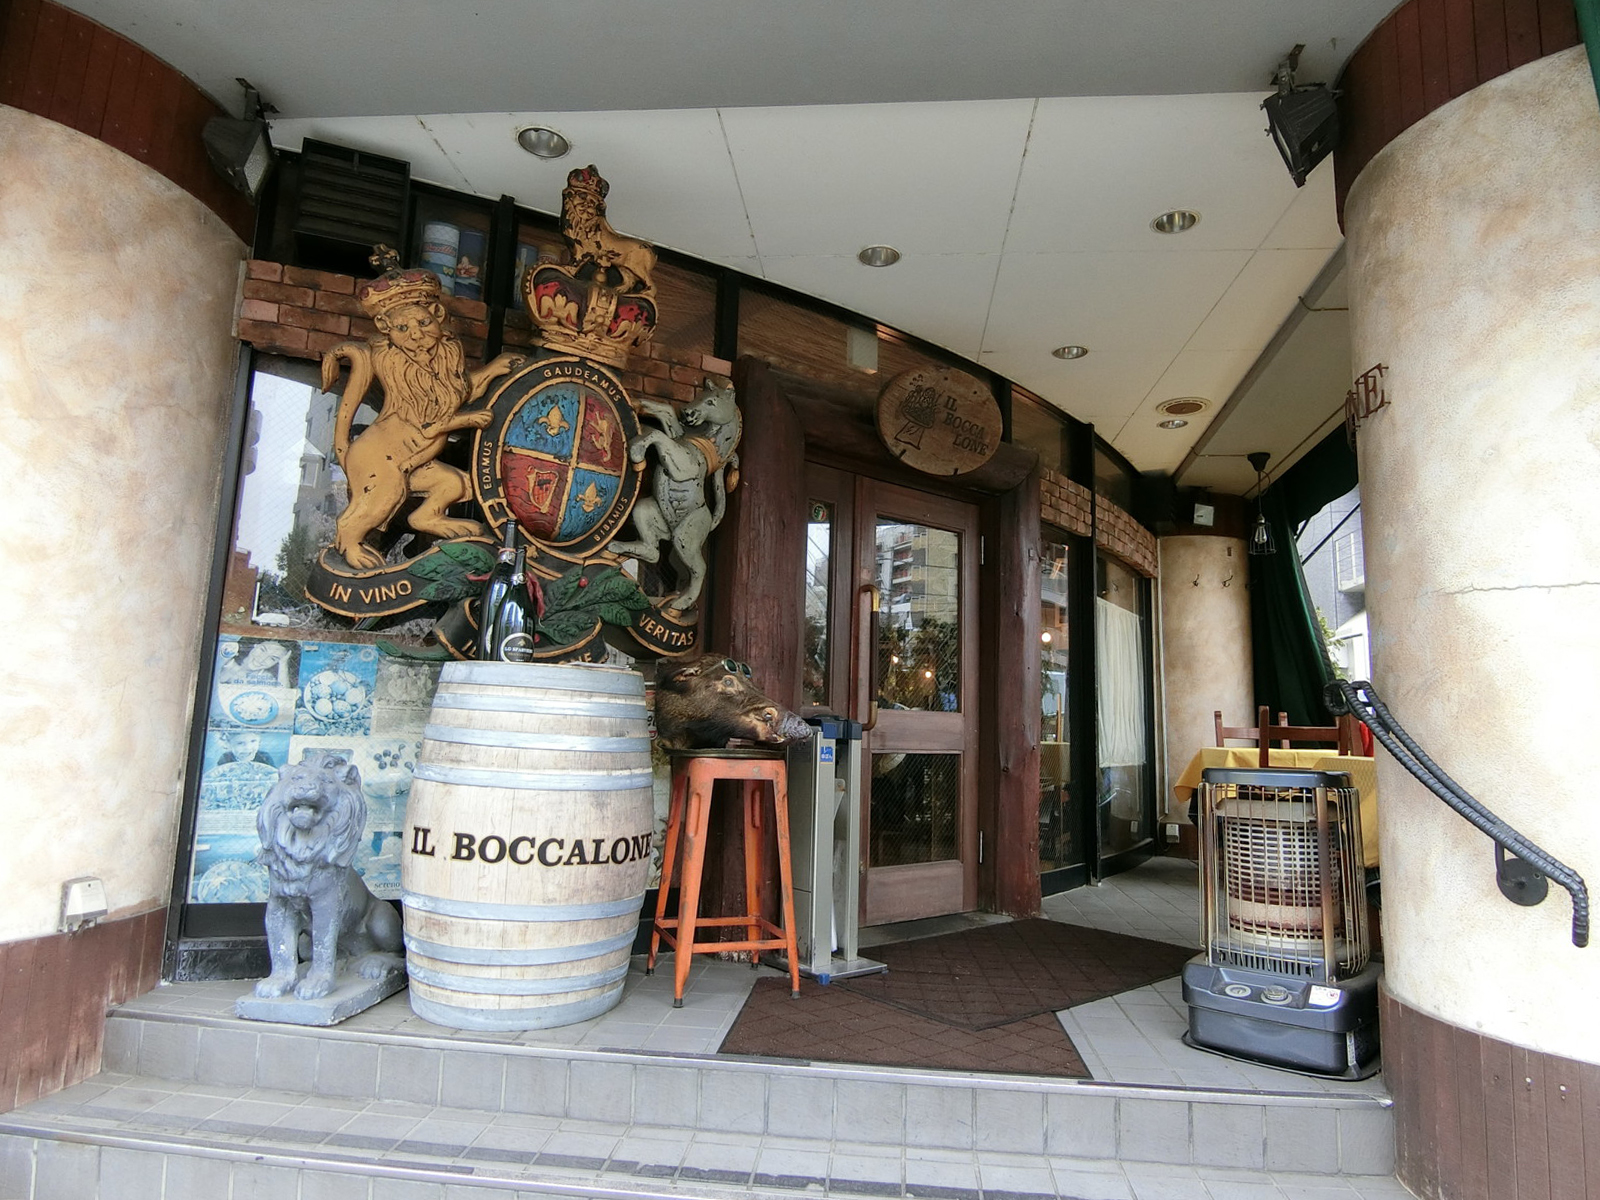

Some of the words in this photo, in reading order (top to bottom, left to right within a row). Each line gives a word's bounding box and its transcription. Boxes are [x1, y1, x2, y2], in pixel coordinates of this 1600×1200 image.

[543, 366, 621, 403] GAUDEAMUS
[943, 396, 957, 412] IL
[943, 412, 985, 440] BOCCA
[952, 434, 989, 456] LONE
[483, 441, 493, 490] EDAMUS
[593, 497, 628, 542] BIBAMUS
[330, 582, 352, 604] IN
[358, 579, 412, 605] VINO
[638, 613, 694, 646] VERITAS
[411, 826, 435, 857] IL
[452, 832, 652, 866] BOCCALONE
